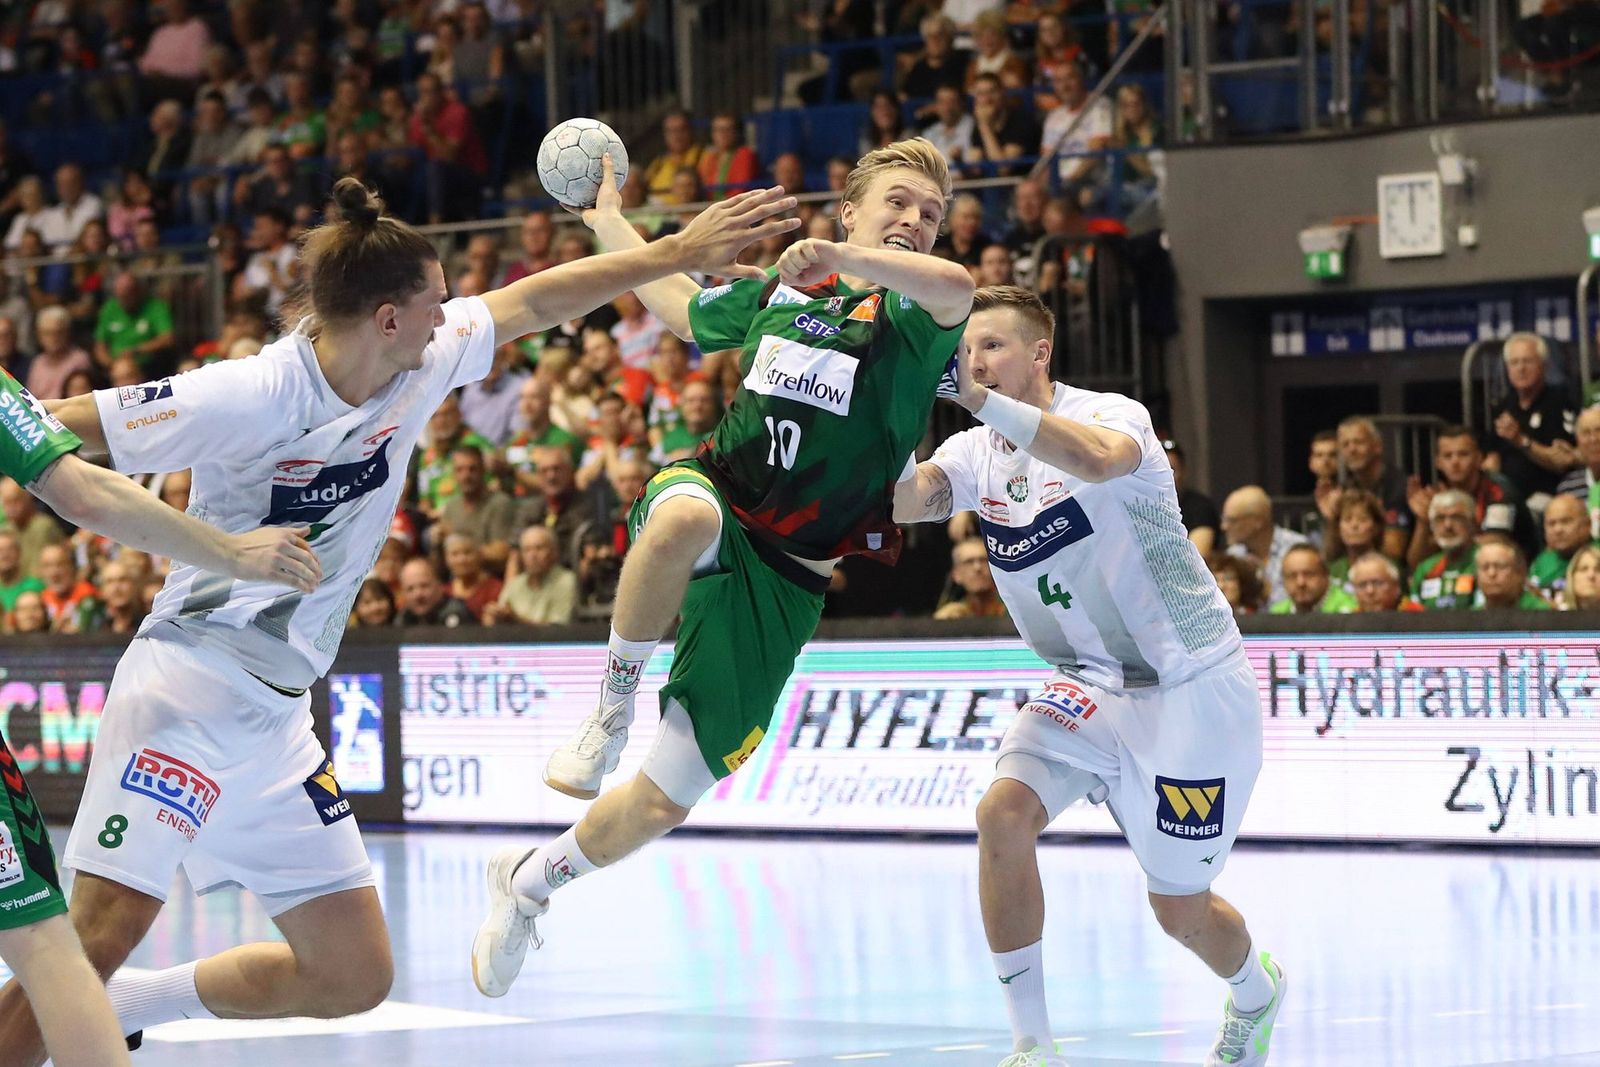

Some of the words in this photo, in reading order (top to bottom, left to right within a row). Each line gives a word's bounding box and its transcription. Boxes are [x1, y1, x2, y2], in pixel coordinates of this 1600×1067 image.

[763, 367, 847, 405] strehlow
[0, 391, 46, 447] SWM
[764, 415, 802, 472] 10
[1037, 573, 1073, 610] 4
[1269, 648, 1600, 736] Hydraulik-
[130, 755, 215, 820] ROTH
[1444, 746, 1598, 832] Zylin
[98, 814, 129, 849] 8
[1160, 818, 1220, 836] WEIMER
[13, 886, 51, 909] hummel
